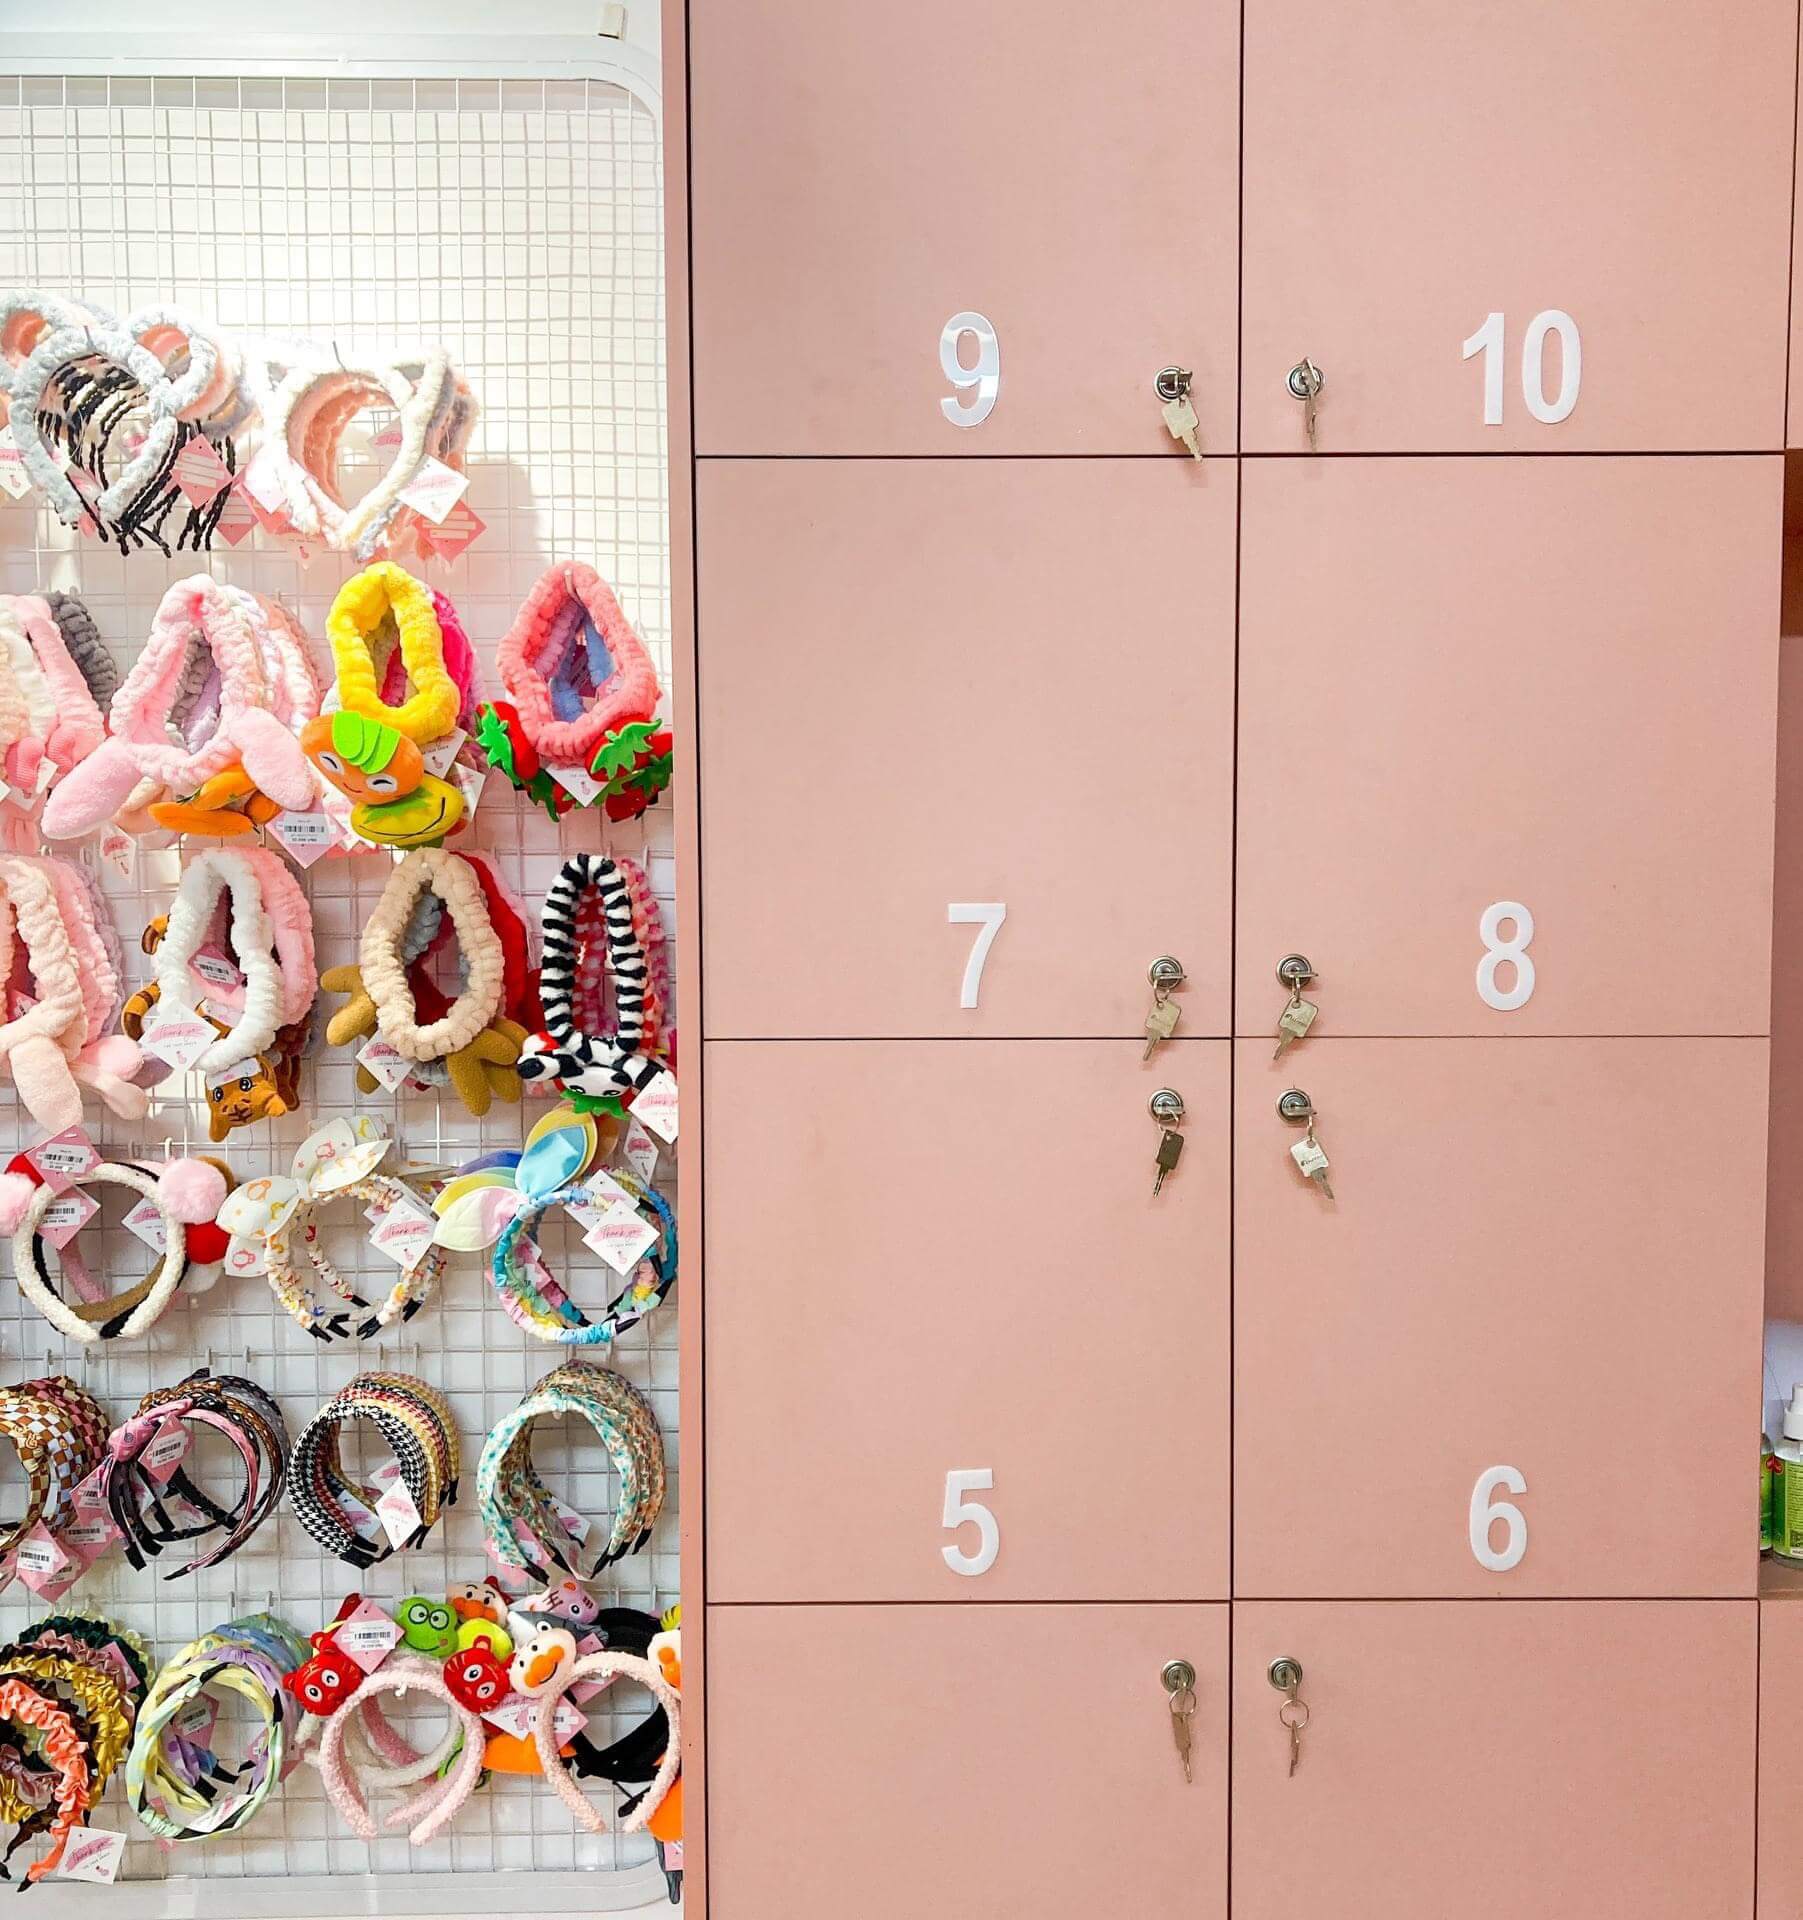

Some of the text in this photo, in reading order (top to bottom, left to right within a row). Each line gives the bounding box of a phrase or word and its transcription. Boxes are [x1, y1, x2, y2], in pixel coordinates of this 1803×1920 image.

[939, 311, 1001, 427] 9
[1461, 309, 1583, 426] 10
[946, 903, 1006, 1009] 7
[1476, 902, 1536, 1012] 8
[602, 1224, 625, 1239] Thank
[941, 1469, 999, 1575] 5
[1470, 1466, 1528, 1571] 6
